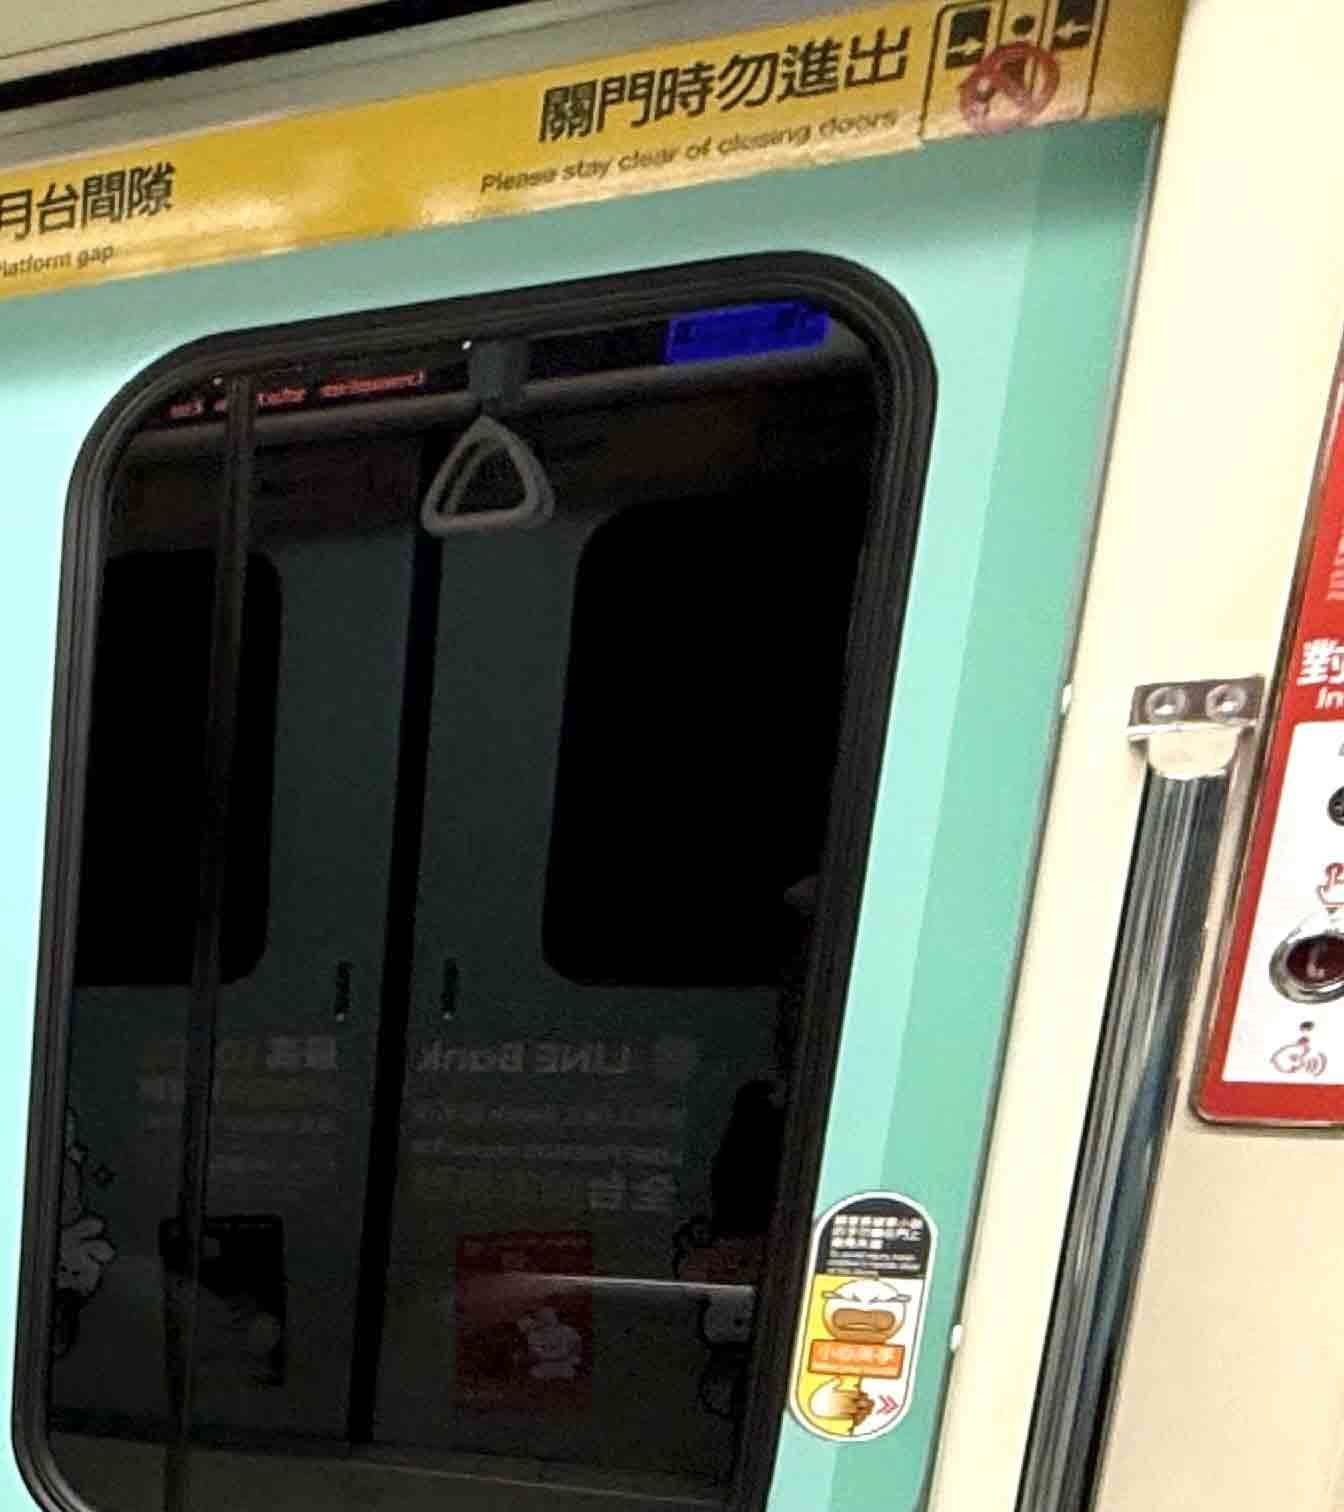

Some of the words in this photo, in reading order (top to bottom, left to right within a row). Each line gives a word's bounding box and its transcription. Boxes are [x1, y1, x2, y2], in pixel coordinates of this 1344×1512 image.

[538, 25, 911, 143] 關門時勿進出
[480, 166, 556, 193] Please
[561, 158, 610, 184] stay
[618, 145, 680, 172] clear
[685, 137, 713, 161] of
[716, 123, 811, 154] closing
[818, 108, 899, 138] doors
[76, 246, 113, 270] gap
